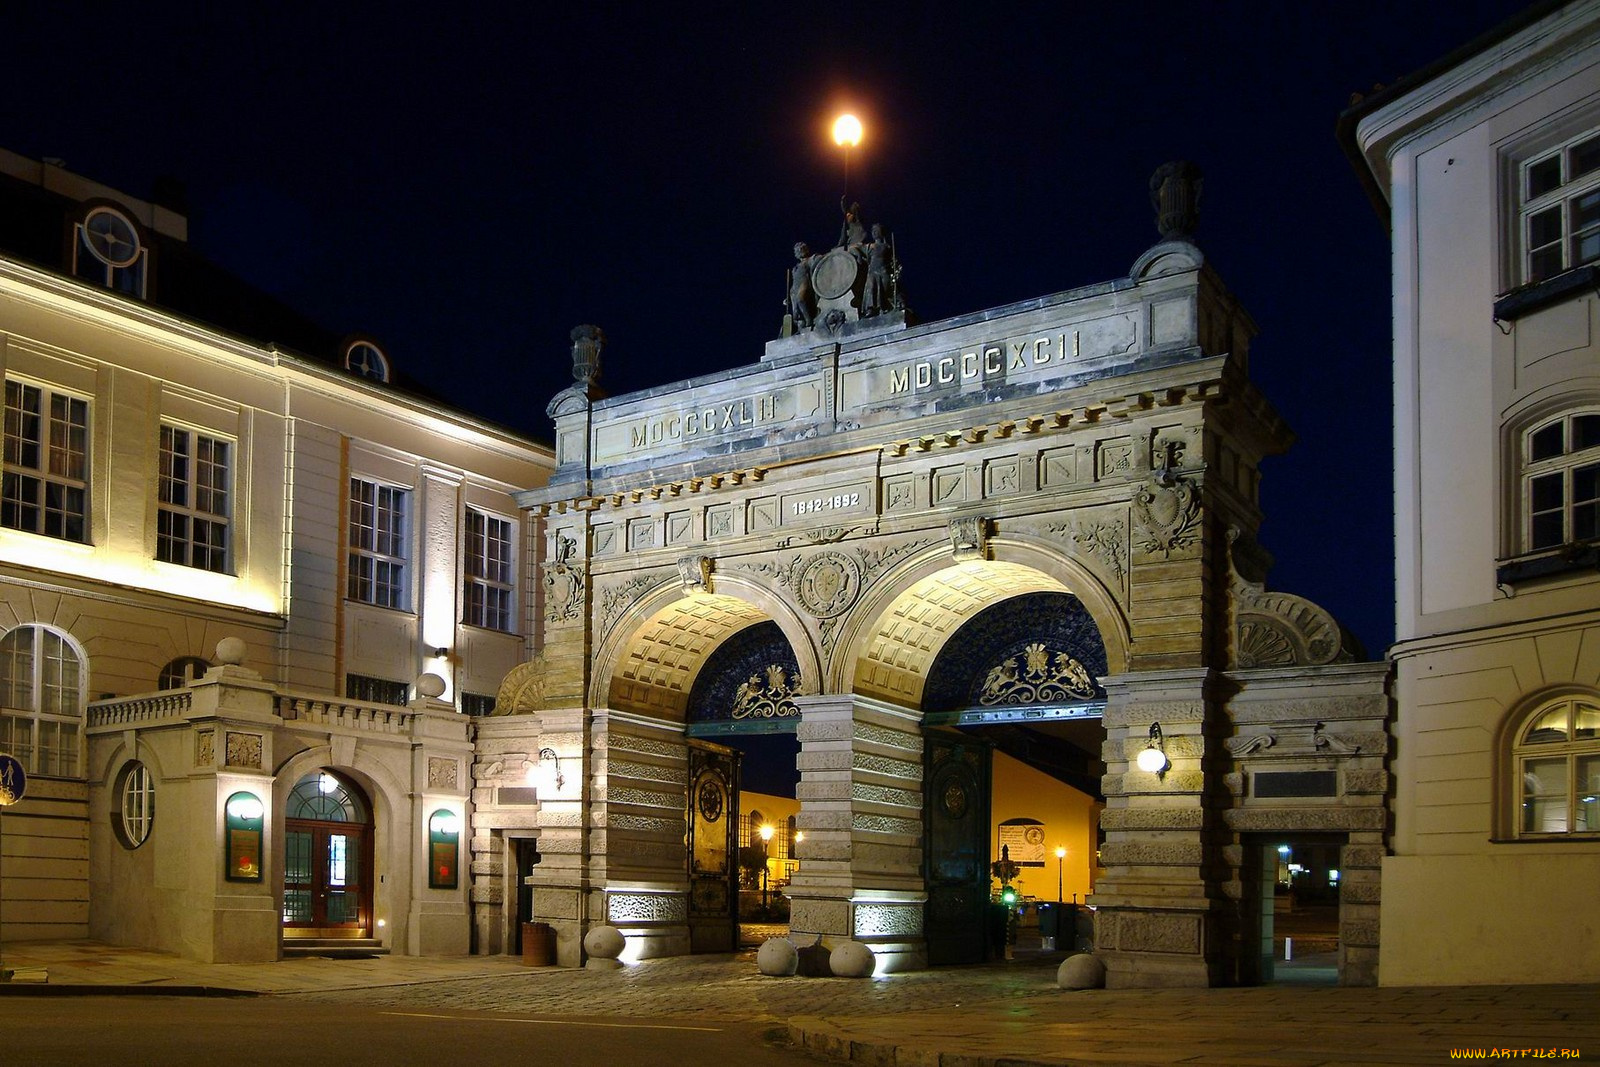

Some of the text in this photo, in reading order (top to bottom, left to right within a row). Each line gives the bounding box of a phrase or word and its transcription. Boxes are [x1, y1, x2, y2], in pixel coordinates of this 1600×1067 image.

[890, 331, 1080, 394] MDCCCXCII
[632, 395, 777, 448] MDCCCXLII
[792, 492, 860, 515] 1842-1892
